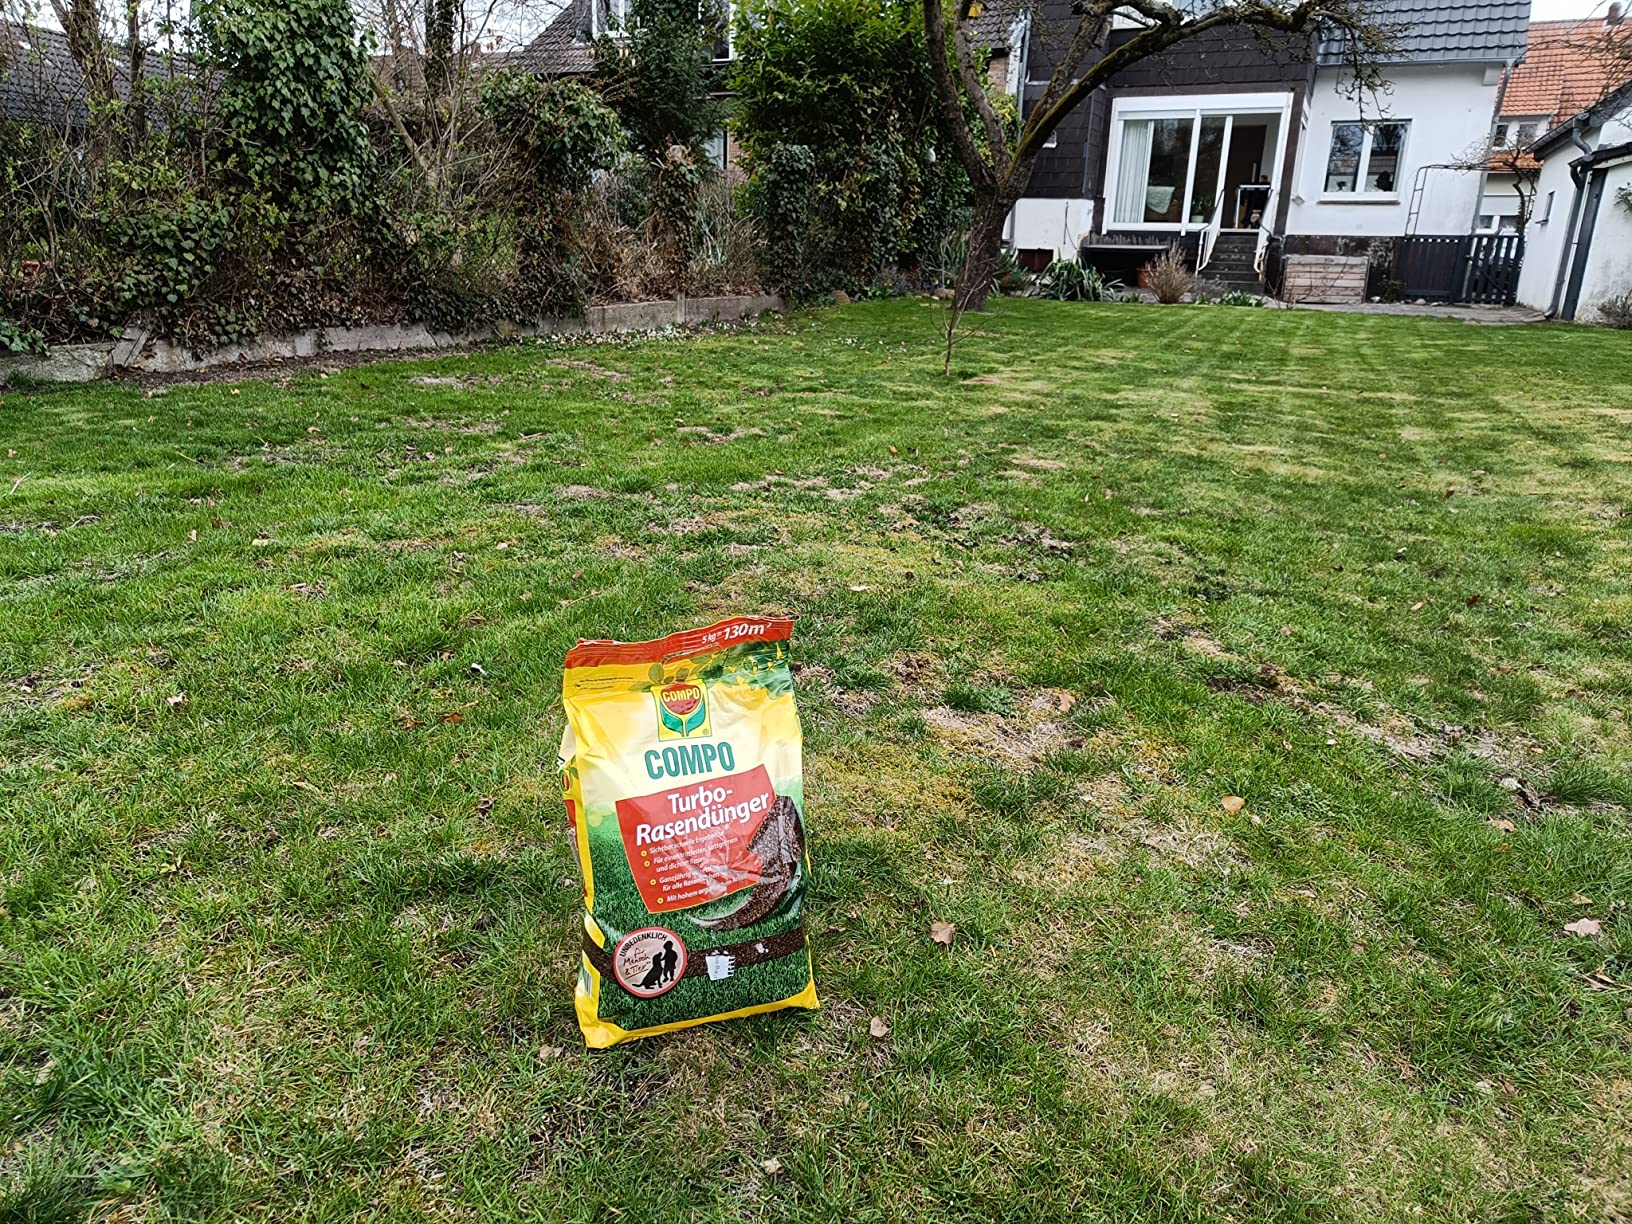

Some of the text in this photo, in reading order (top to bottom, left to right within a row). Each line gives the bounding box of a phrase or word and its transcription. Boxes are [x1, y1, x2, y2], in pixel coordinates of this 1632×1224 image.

[662, 687, 700, 702] COMPO
[644, 741, 735, 780] COMPO
[667, 786, 733, 814] Turbo-
[636, 792, 769, 846] Rasendünger
[656, 865, 668, 873] und
[666, 894, 677, 902] Mit
[619, 932, 668, 957] UNBEDENKLICH
